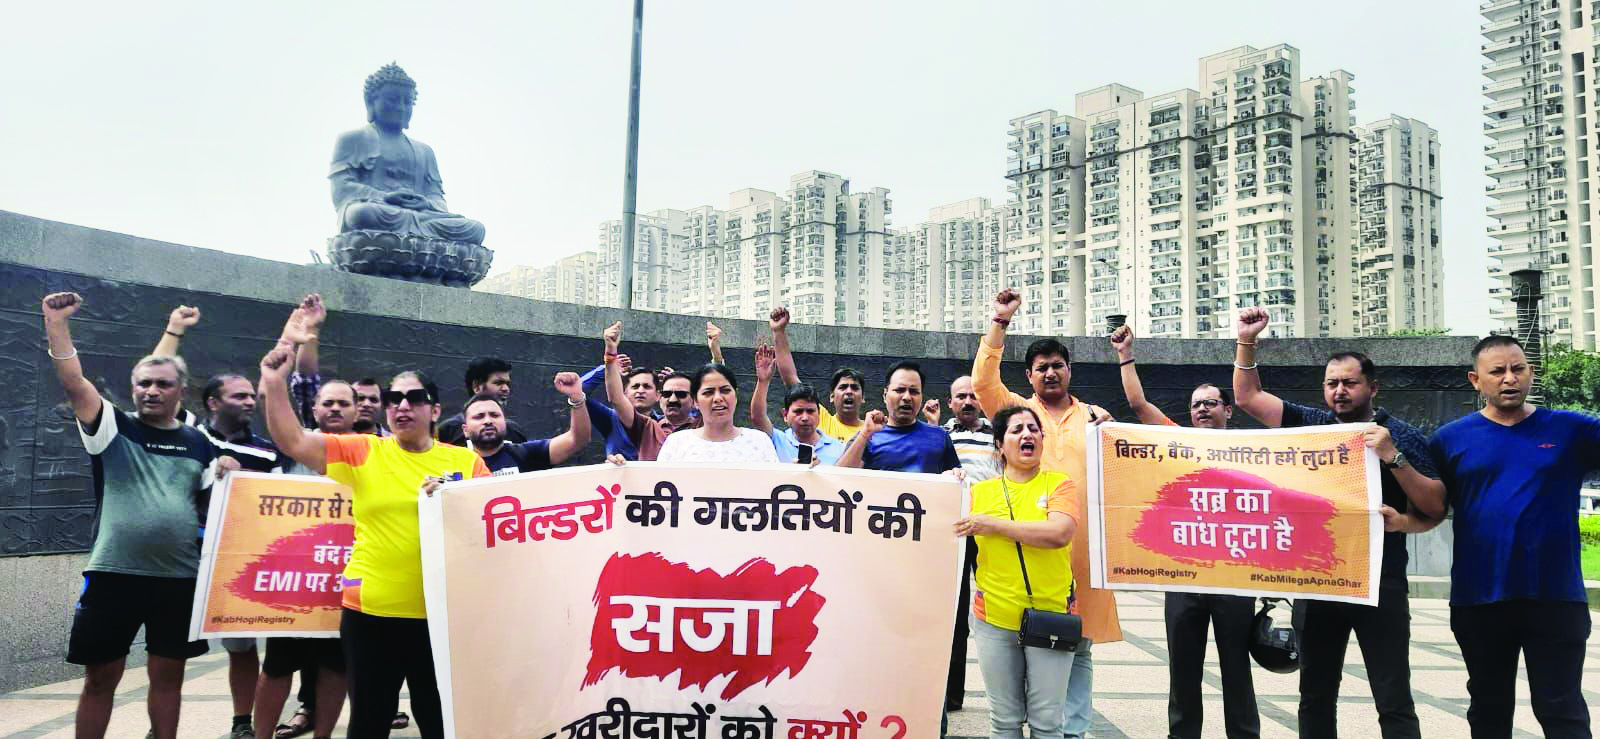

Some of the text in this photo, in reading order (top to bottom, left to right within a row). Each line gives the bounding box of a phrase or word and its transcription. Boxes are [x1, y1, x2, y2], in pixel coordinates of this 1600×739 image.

[1274, 446, 1300, 465] हमें
[1301, 449, 1335, 471] लुटा
[1337, 442, 1350, 465] है
[259, 494, 324, 518] सरकार
[327, 492, 344, 519] से
[482, 480, 926, 548] बिल्डरों की गलतियों की
[1188, 487, 1273, 514] सब्र का
[1170, 515, 1295, 559] बांध टूटा है
[313, 539, 341, 565] बंद
[254, 571, 302, 592] EMI
[305, 572, 331, 592] पर
[1112, 567, 1198, 579] #KabHogiRegistry
[1250, 573, 1362, 589] #KabMilegaApnaGhar
[211, 615, 296, 625] #KabHogiRegistry
[610, 595, 782, 656] सजा
[720, 705, 777, 739] को
[787, 709, 867, 739] क्यों
